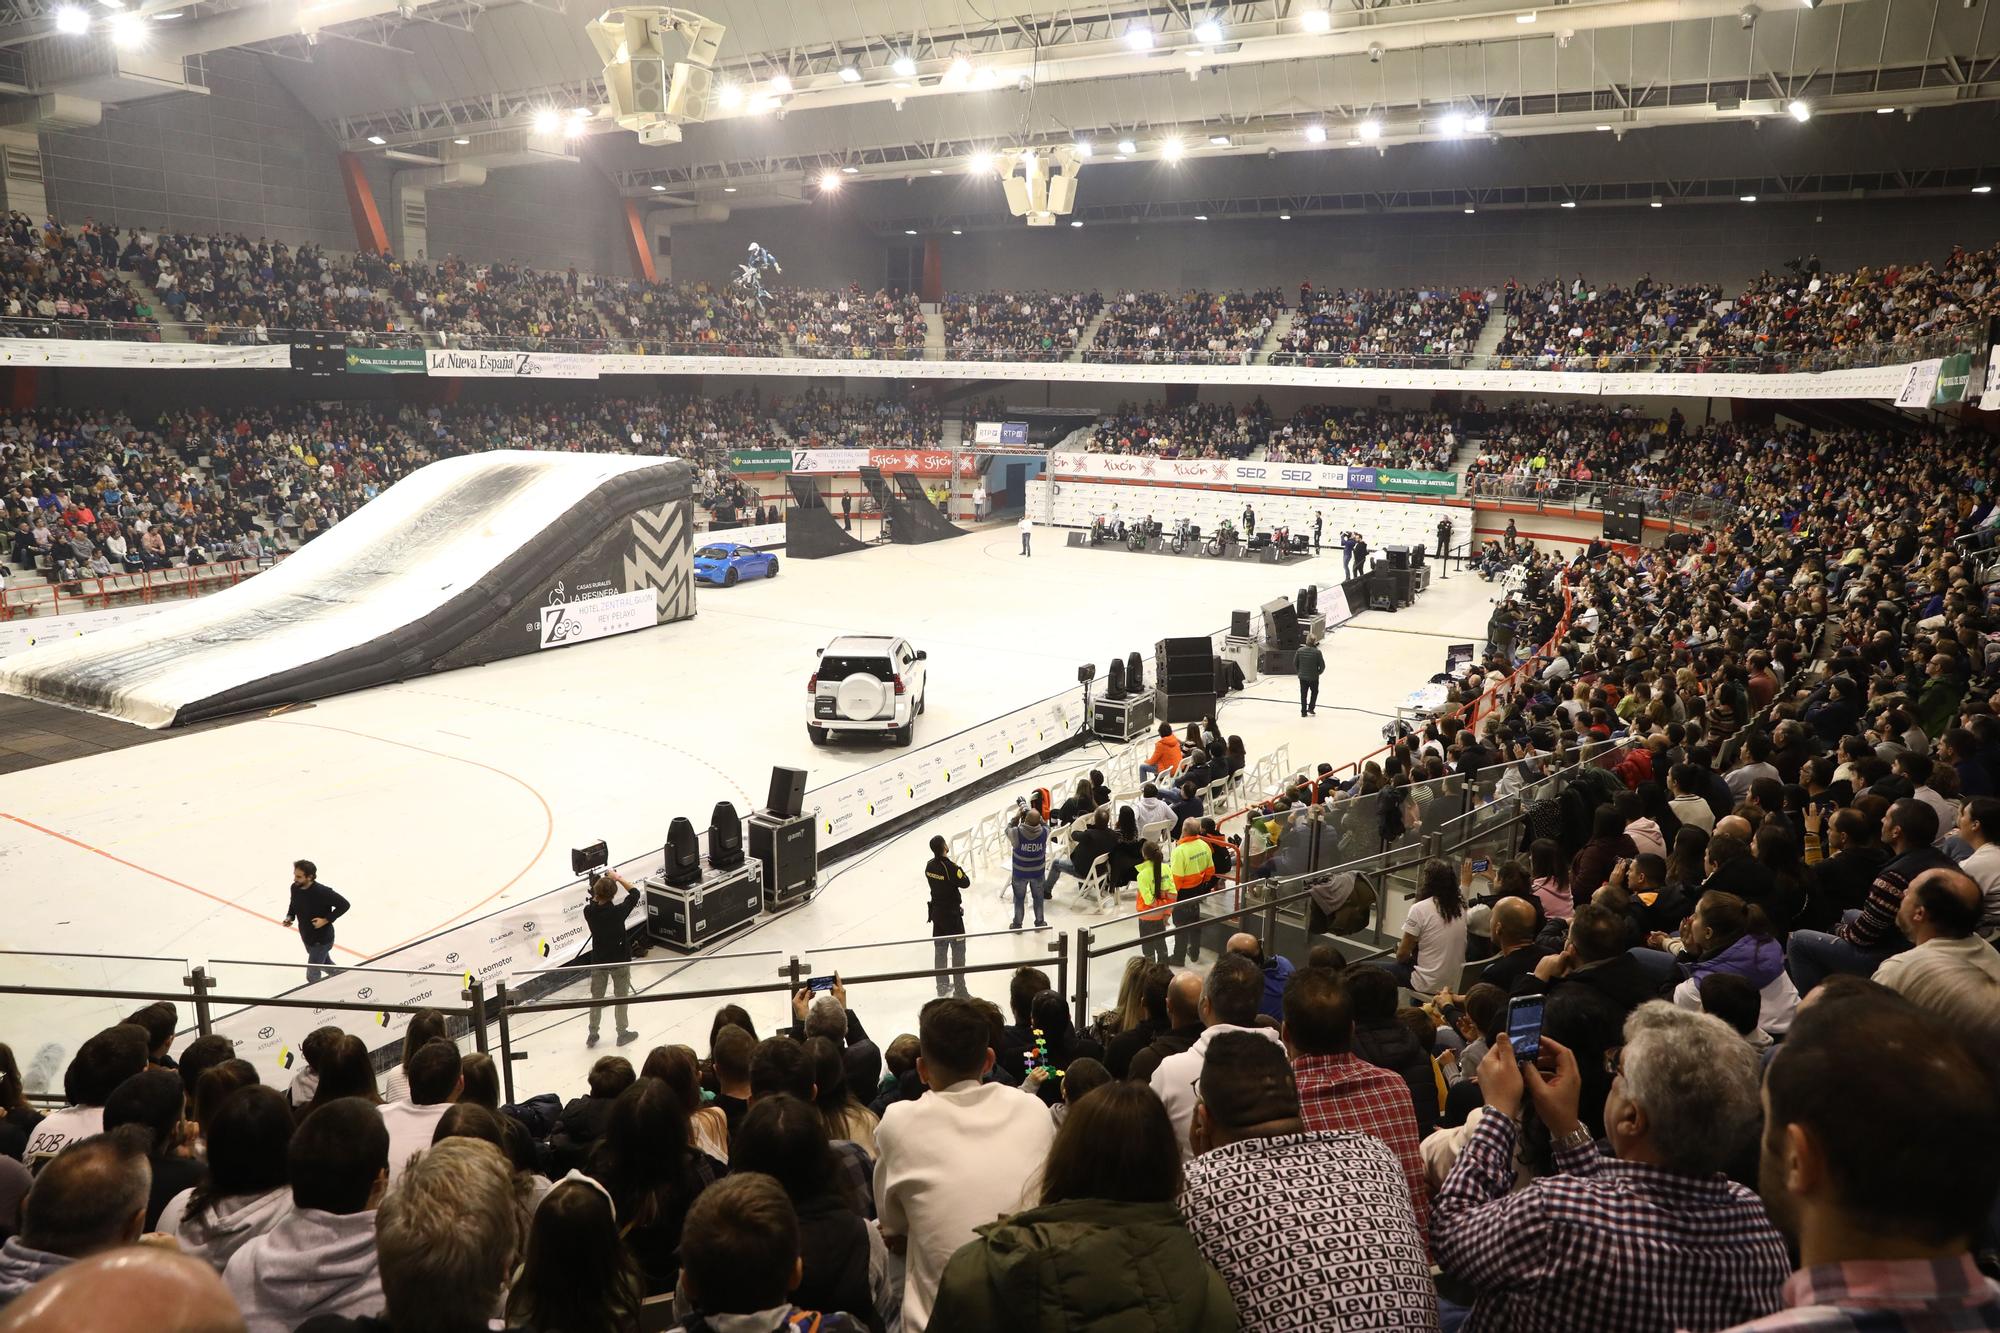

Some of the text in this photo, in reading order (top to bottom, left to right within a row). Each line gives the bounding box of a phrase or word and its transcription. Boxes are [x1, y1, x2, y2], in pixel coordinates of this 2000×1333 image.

[432, 354, 513, 372] La Nueva España
[871, 453, 901, 468] gijón
[925, 454, 953, 470] gijón
[1236, 467, 1267, 479] SER
[1281, 470, 1312, 482] SER
[570, 588, 618, 603] LA RESINERA
[579, 604, 599, 614] HOTEL
[601, 597, 633, 611] ZENTRAL
[598, 609, 636, 622] REY PELAYO
[1021, 843, 1042, 852] MEDIA
[552, 926, 583, 943] Leomotor
[555, 939, 574, 950] Ocasión
[478, 956, 513, 975] Leomotor
[480, 969, 502, 982] Ocasión
[28, 1133, 65, 1154] BOB
